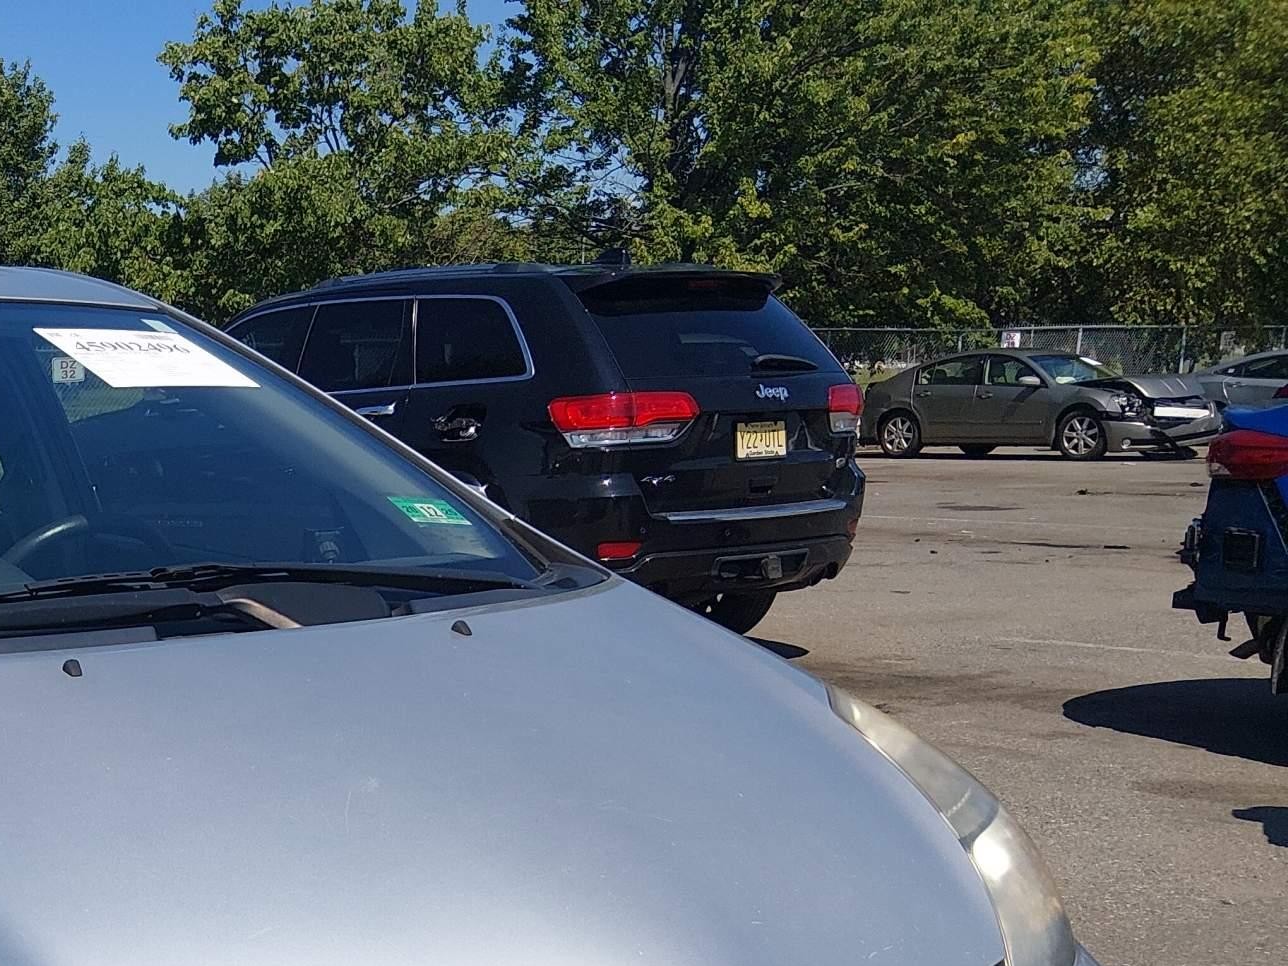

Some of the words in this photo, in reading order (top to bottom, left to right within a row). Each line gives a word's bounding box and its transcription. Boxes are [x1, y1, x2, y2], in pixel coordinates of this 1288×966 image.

[75, 341, 191, 353] 45902496
[60, 360, 76, 369] DZ
[61, 370, 76, 379] 32
[756, 383, 789, 400] Jeep
[420, 505, 444, 518] 12
